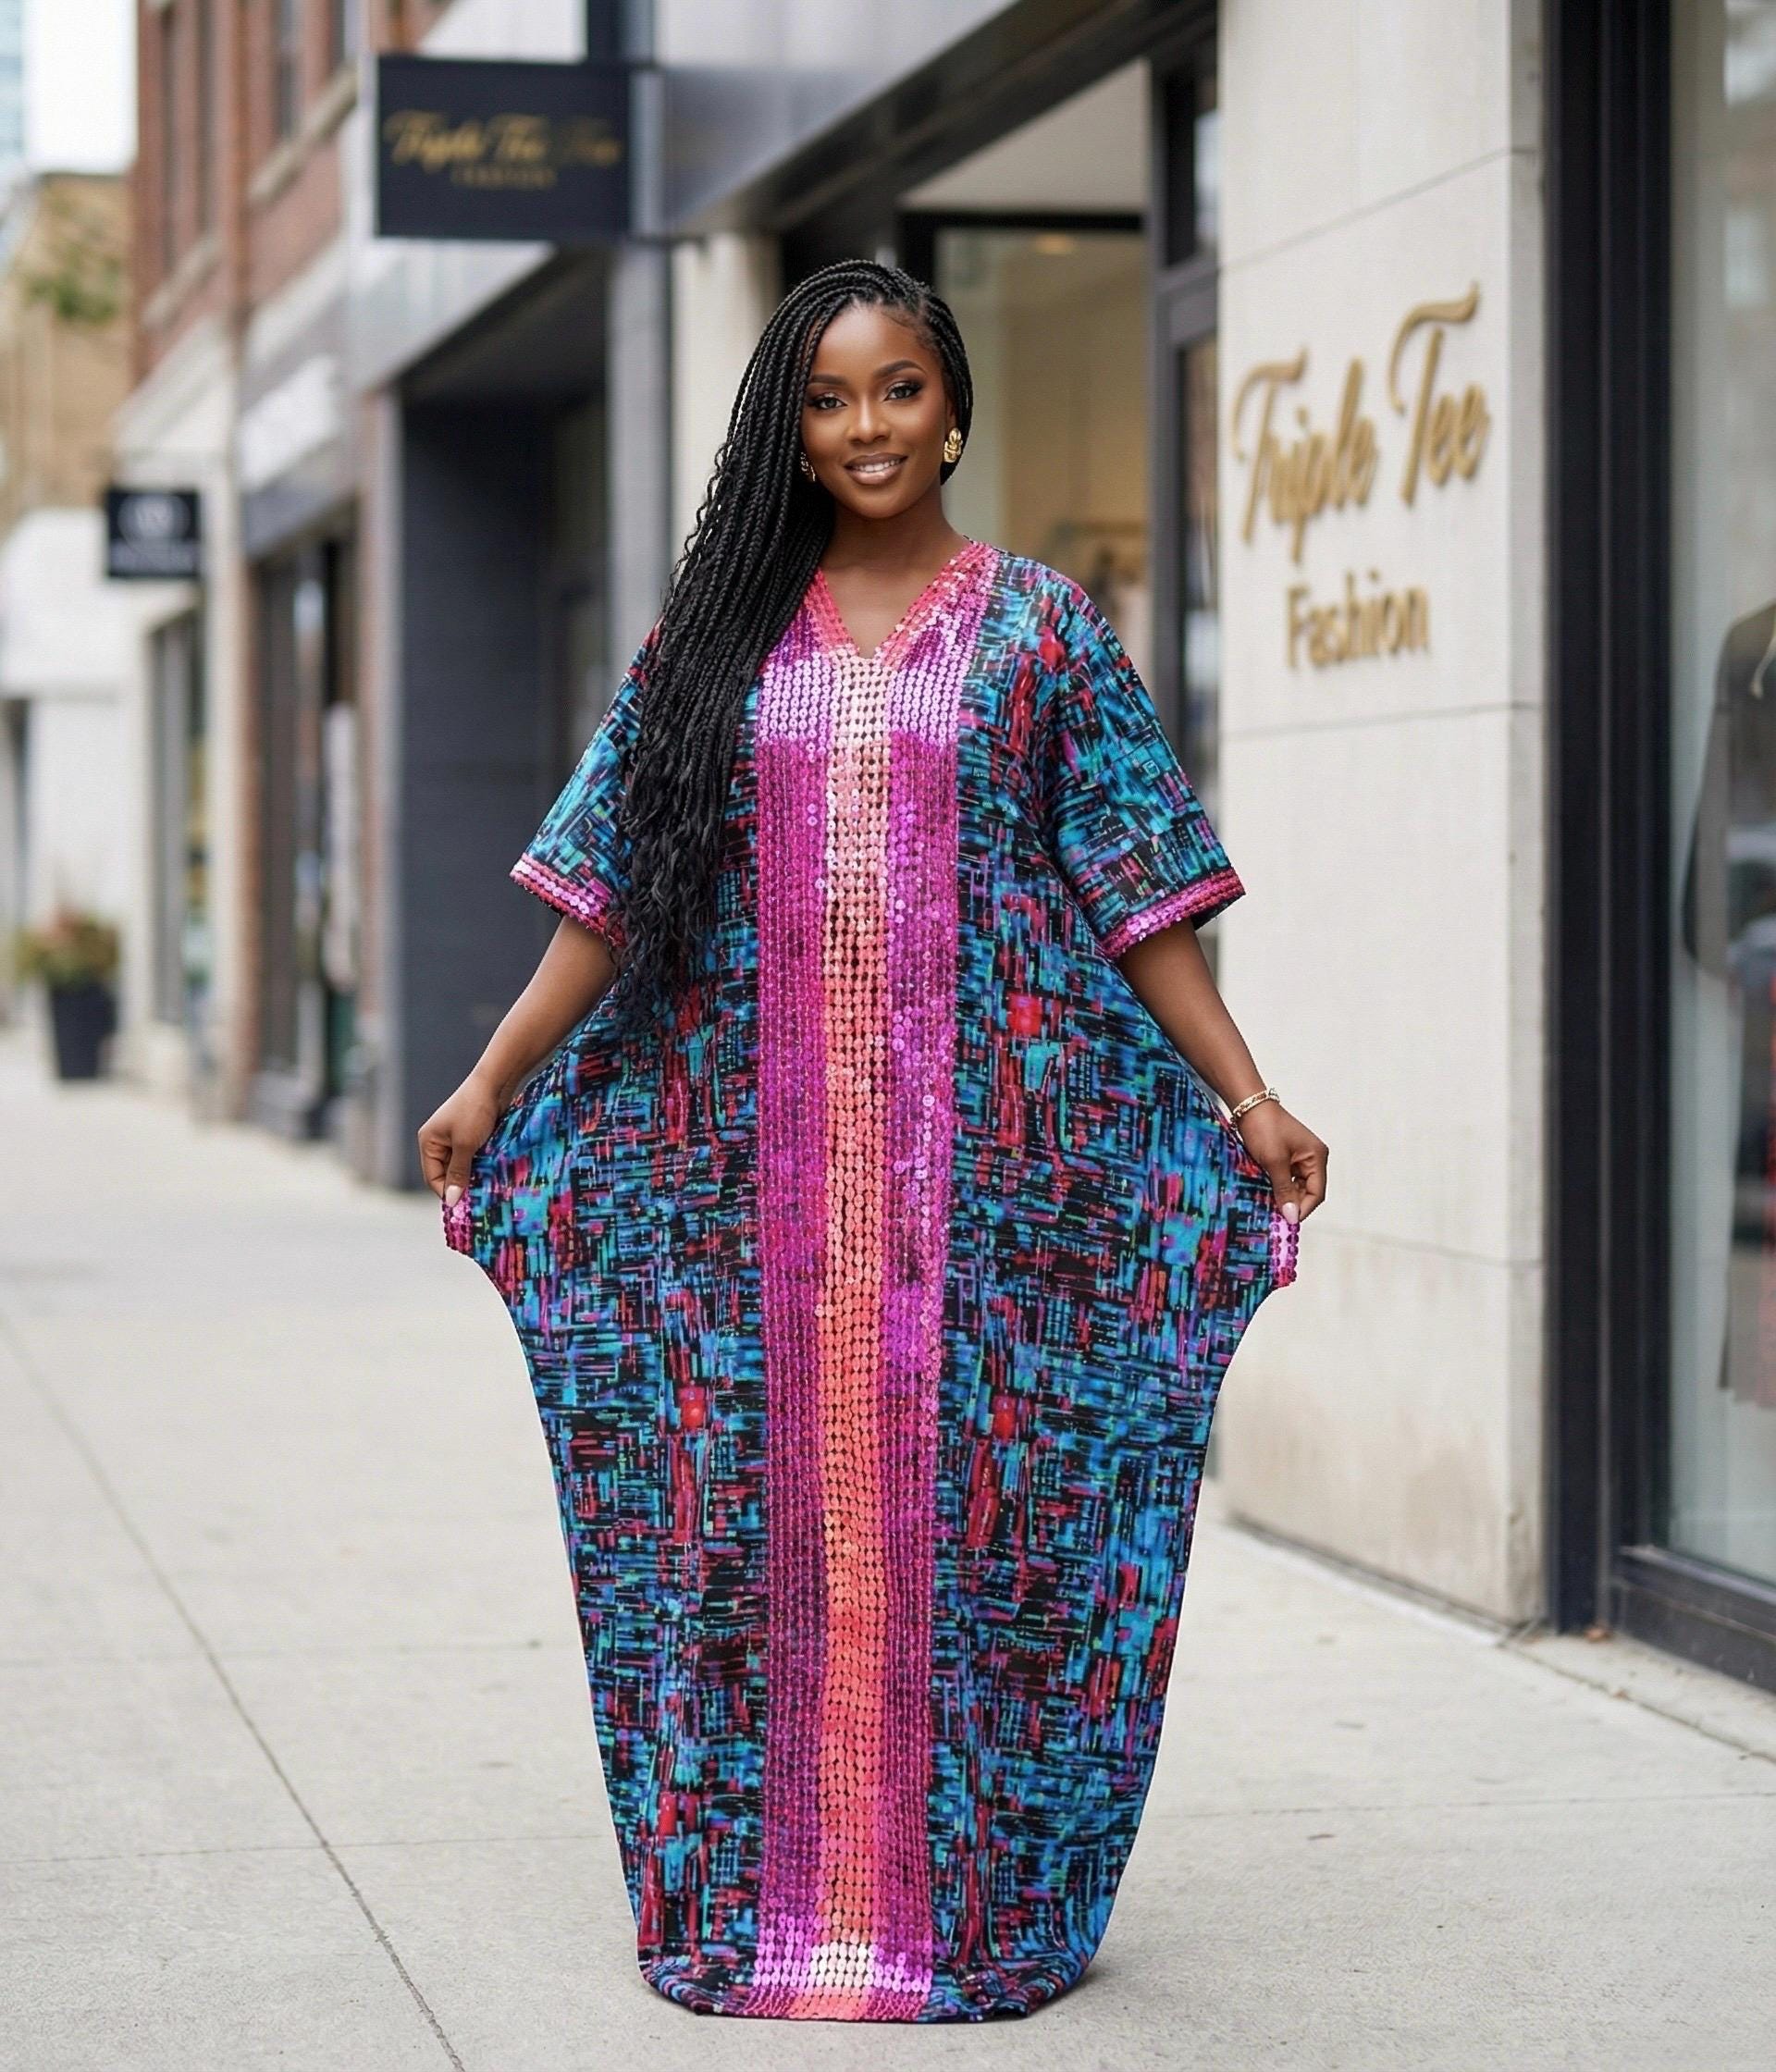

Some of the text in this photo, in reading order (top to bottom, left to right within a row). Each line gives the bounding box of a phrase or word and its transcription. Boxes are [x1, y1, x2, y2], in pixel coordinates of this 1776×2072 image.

[1232, 281, 1490, 563] Triple Tee
[1287, 568, 1431, 669] Fashion
